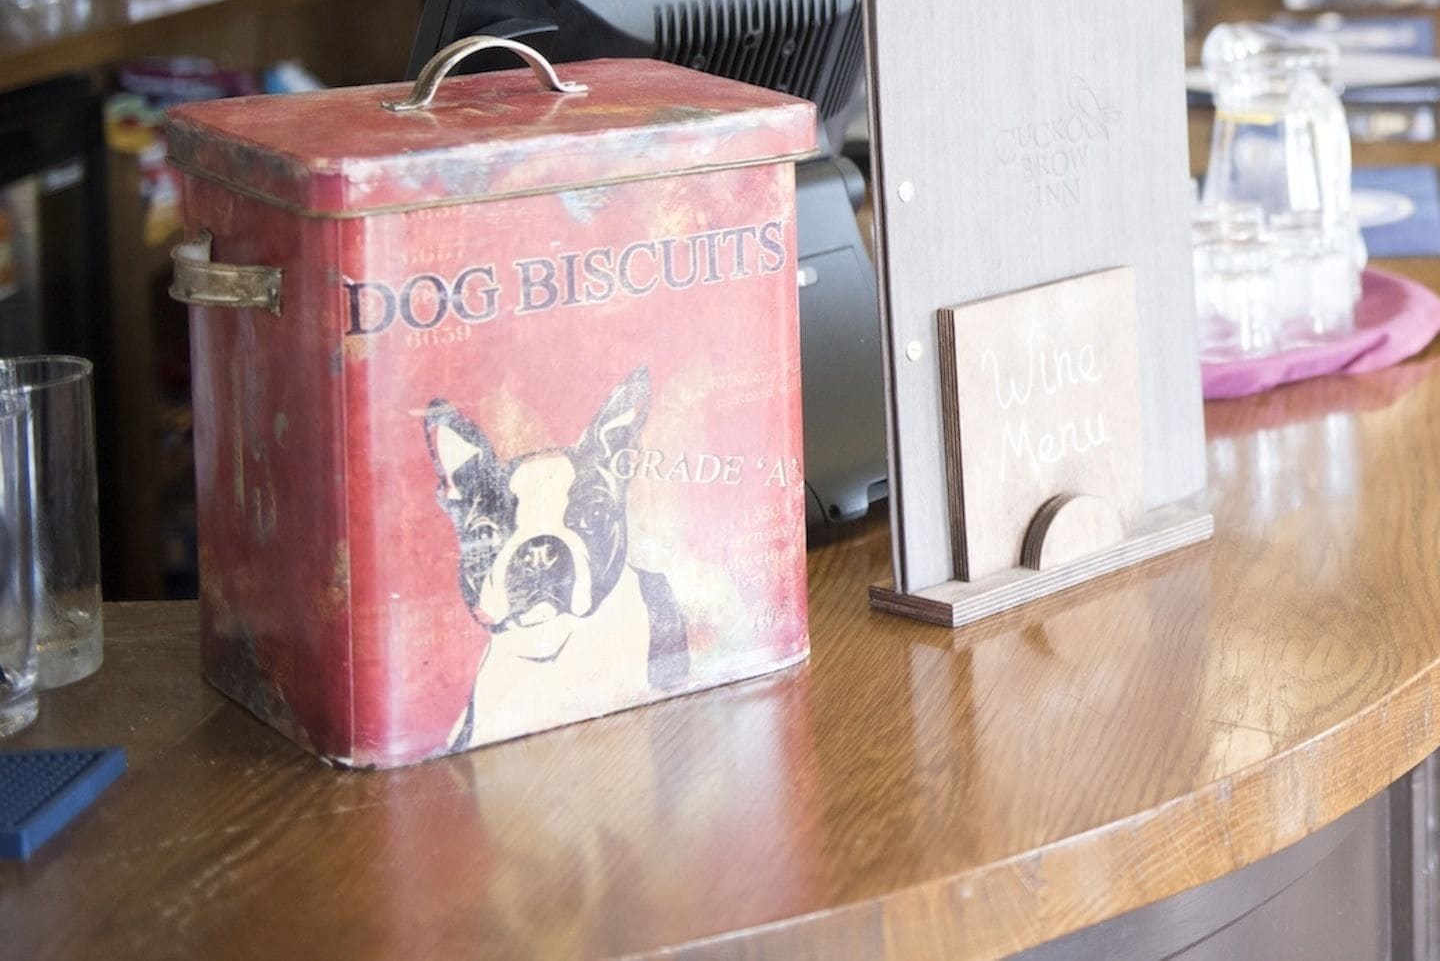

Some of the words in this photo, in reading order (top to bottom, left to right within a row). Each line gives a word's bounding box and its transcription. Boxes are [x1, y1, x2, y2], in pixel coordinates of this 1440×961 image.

[1020, 144, 1089, 183] BROW
[1032, 177, 1081, 208] INN
[343, 262, 501, 336] DOG
[513, 218, 788, 315] BISCUITS
[980, 317, 1103, 410] Wine
[609, 446, 746, 487] GRADE
[1000, 411, 1114, 485] Menu
